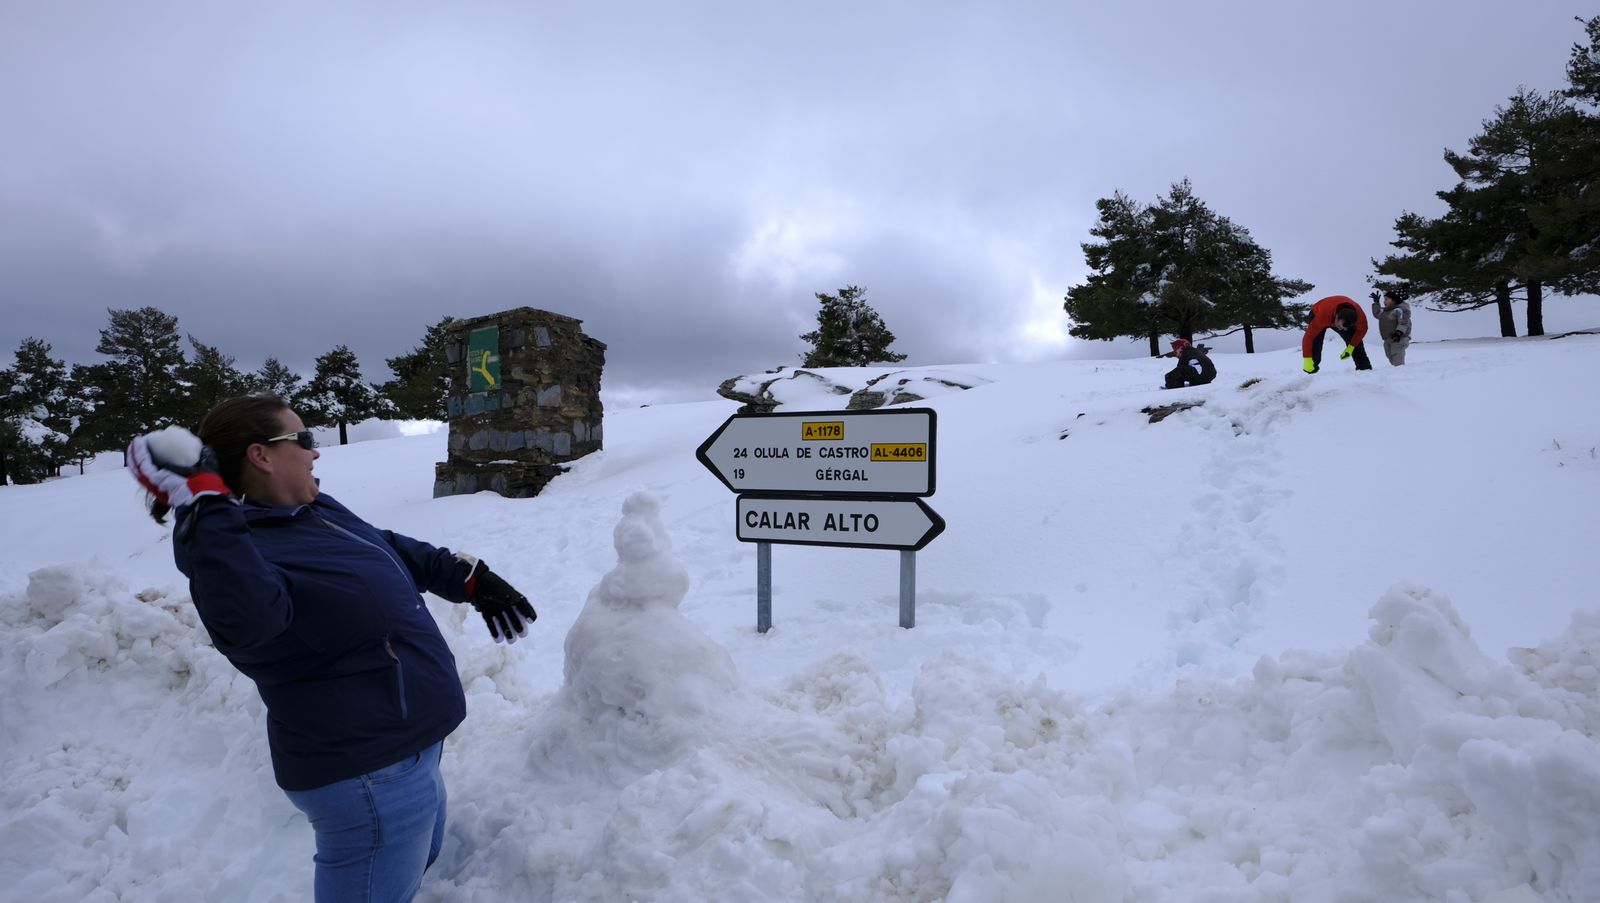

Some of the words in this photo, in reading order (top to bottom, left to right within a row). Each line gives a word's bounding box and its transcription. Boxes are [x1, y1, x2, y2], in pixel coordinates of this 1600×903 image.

[805, 425, 841, 437] A-1178
[732, 447, 749, 459] 24
[754, 447, 790, 459] OLULA
[796, 447, 812, 459] DE
[818, 447, 869, 459] CASTRO
[874, 447, 923, 458] AL-4406
[733, 468, 746, 480] 19
[815, 467, 869, 481] GÉRGAL
[745, 510, 811, 530] CALAR
[823, 513, 880, 533] ALTO
